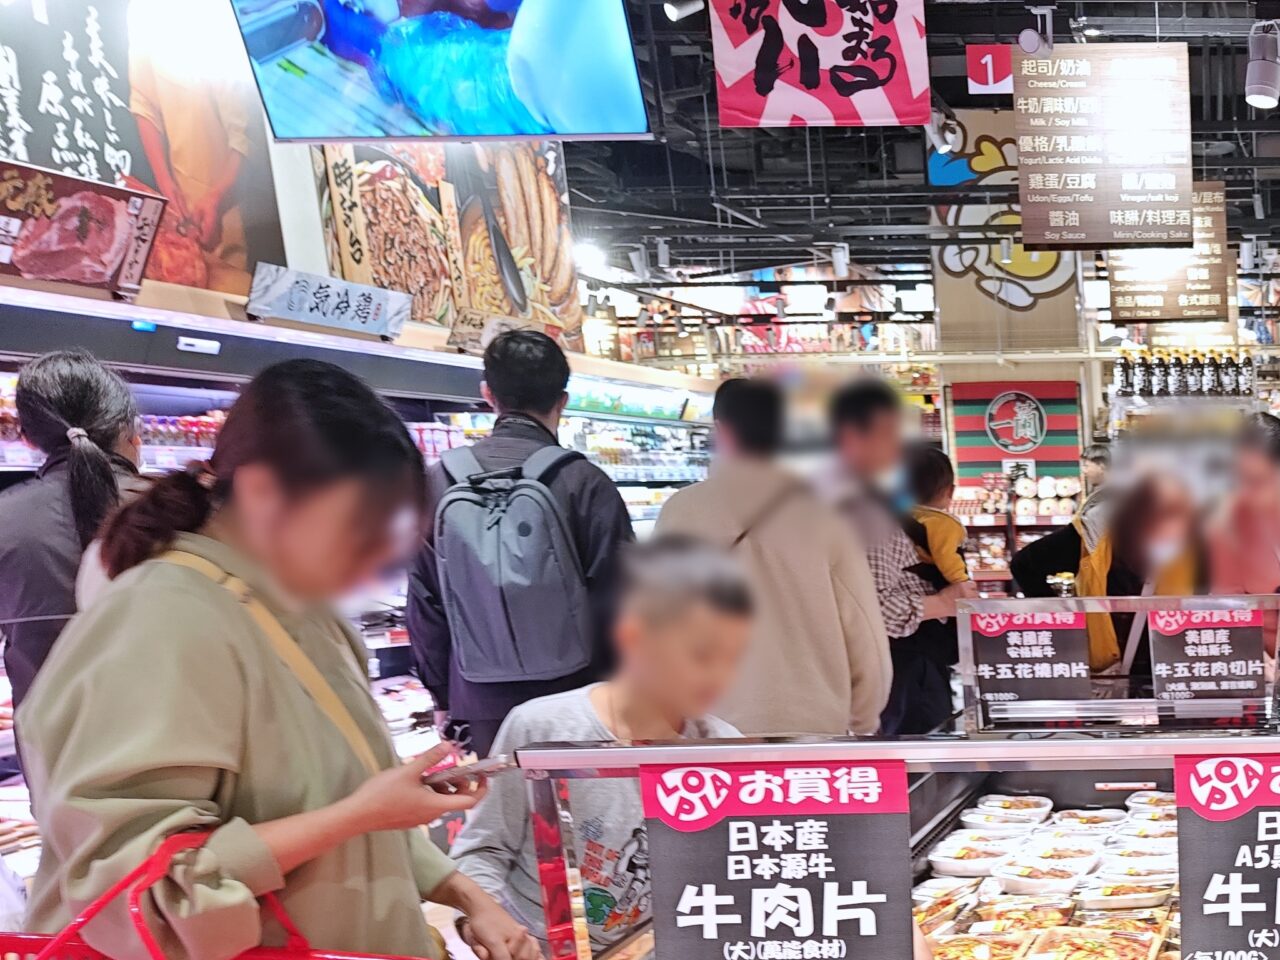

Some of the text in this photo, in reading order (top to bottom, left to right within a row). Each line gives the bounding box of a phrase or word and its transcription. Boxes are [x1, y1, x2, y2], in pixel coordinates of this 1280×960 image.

[980, 53, 994, 86] 1
[1021, 59, 1091, 76] 起司/奶油
[1030, 118, 1047, 127] Milk
[1054, 118, 1071, 127] Soy
[1044, 231, 1087, 241] Soy Sauce
[1169, 231, 1189, 239] Sake
[1154, 660, 1265, 678] 牛五花肉切片
[738, 767, 882, 804] お買得
[676, 880, 887, 939] 牛肉片
